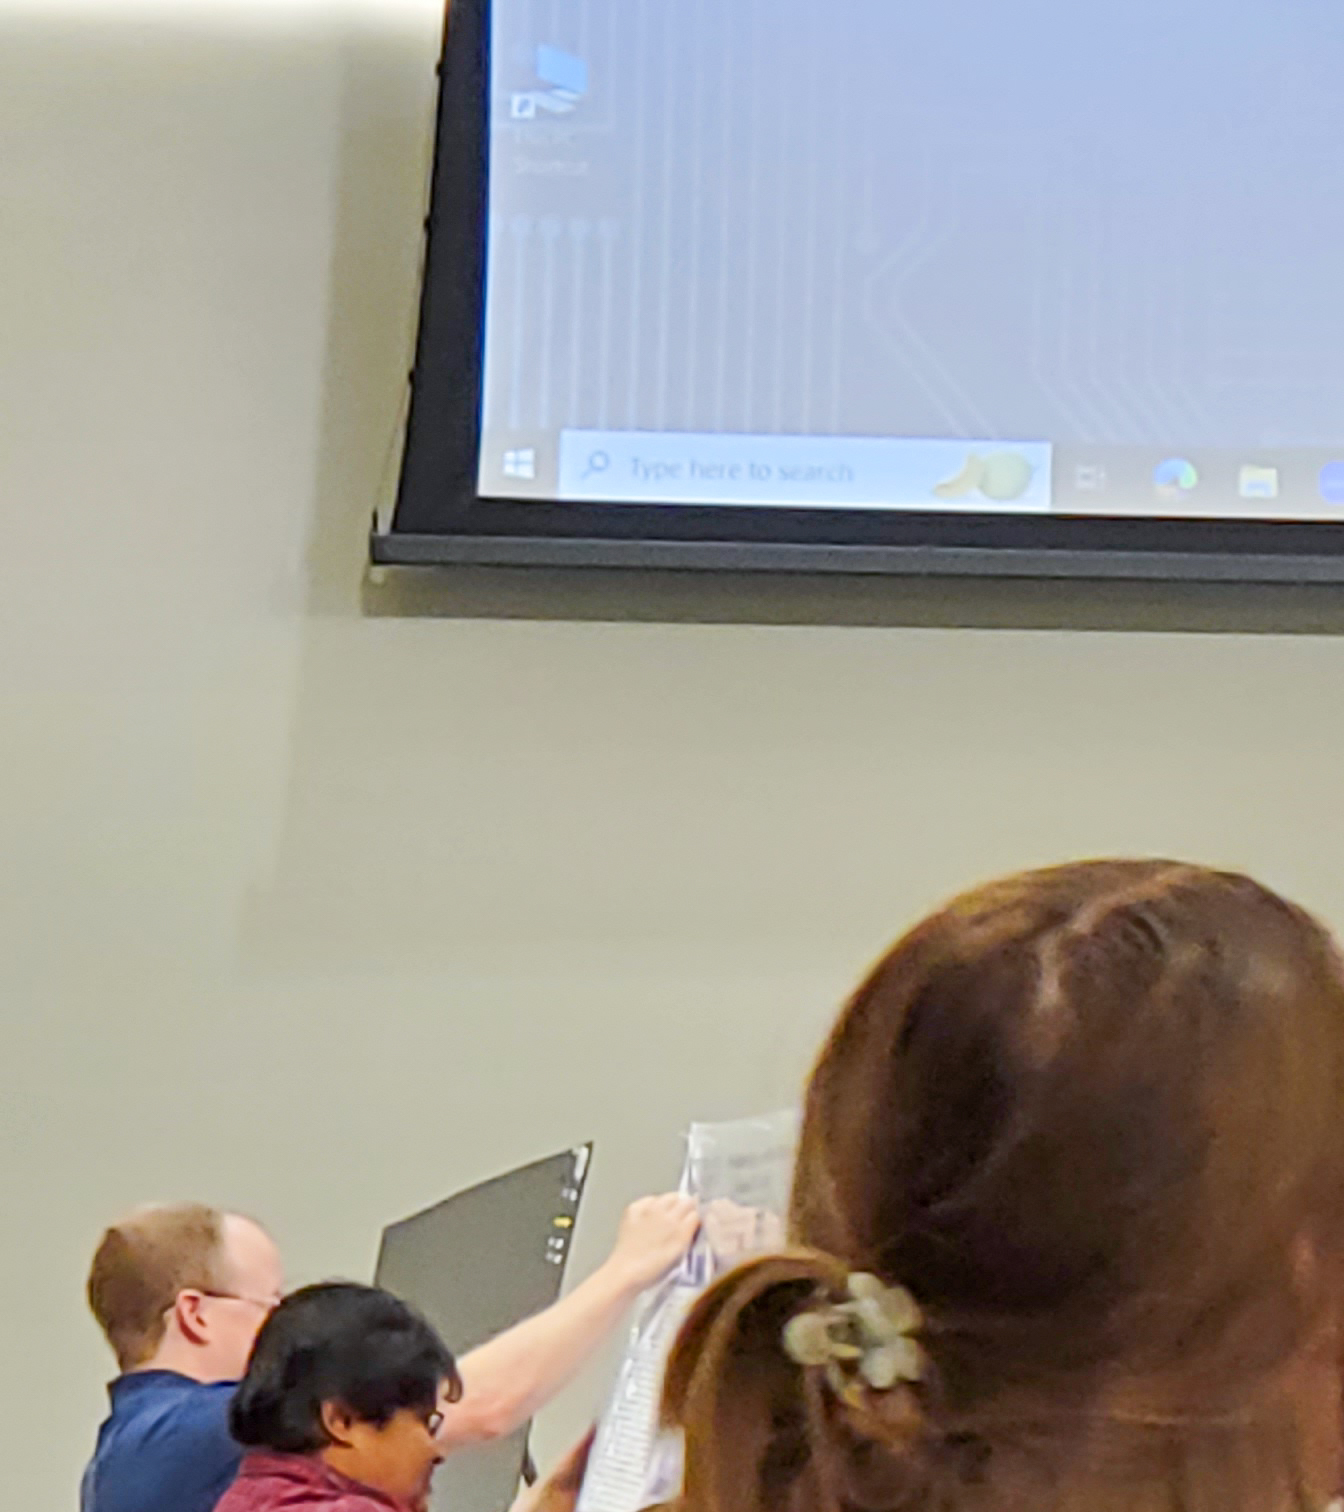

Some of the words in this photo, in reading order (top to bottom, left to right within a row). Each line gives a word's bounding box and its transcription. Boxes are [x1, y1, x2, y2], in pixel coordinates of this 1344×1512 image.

[632, 456, 681, 482] Type
[689, 457, 744, 482] here
[750, 461, 771, 482] to
[777, 461, 855, 483] search
